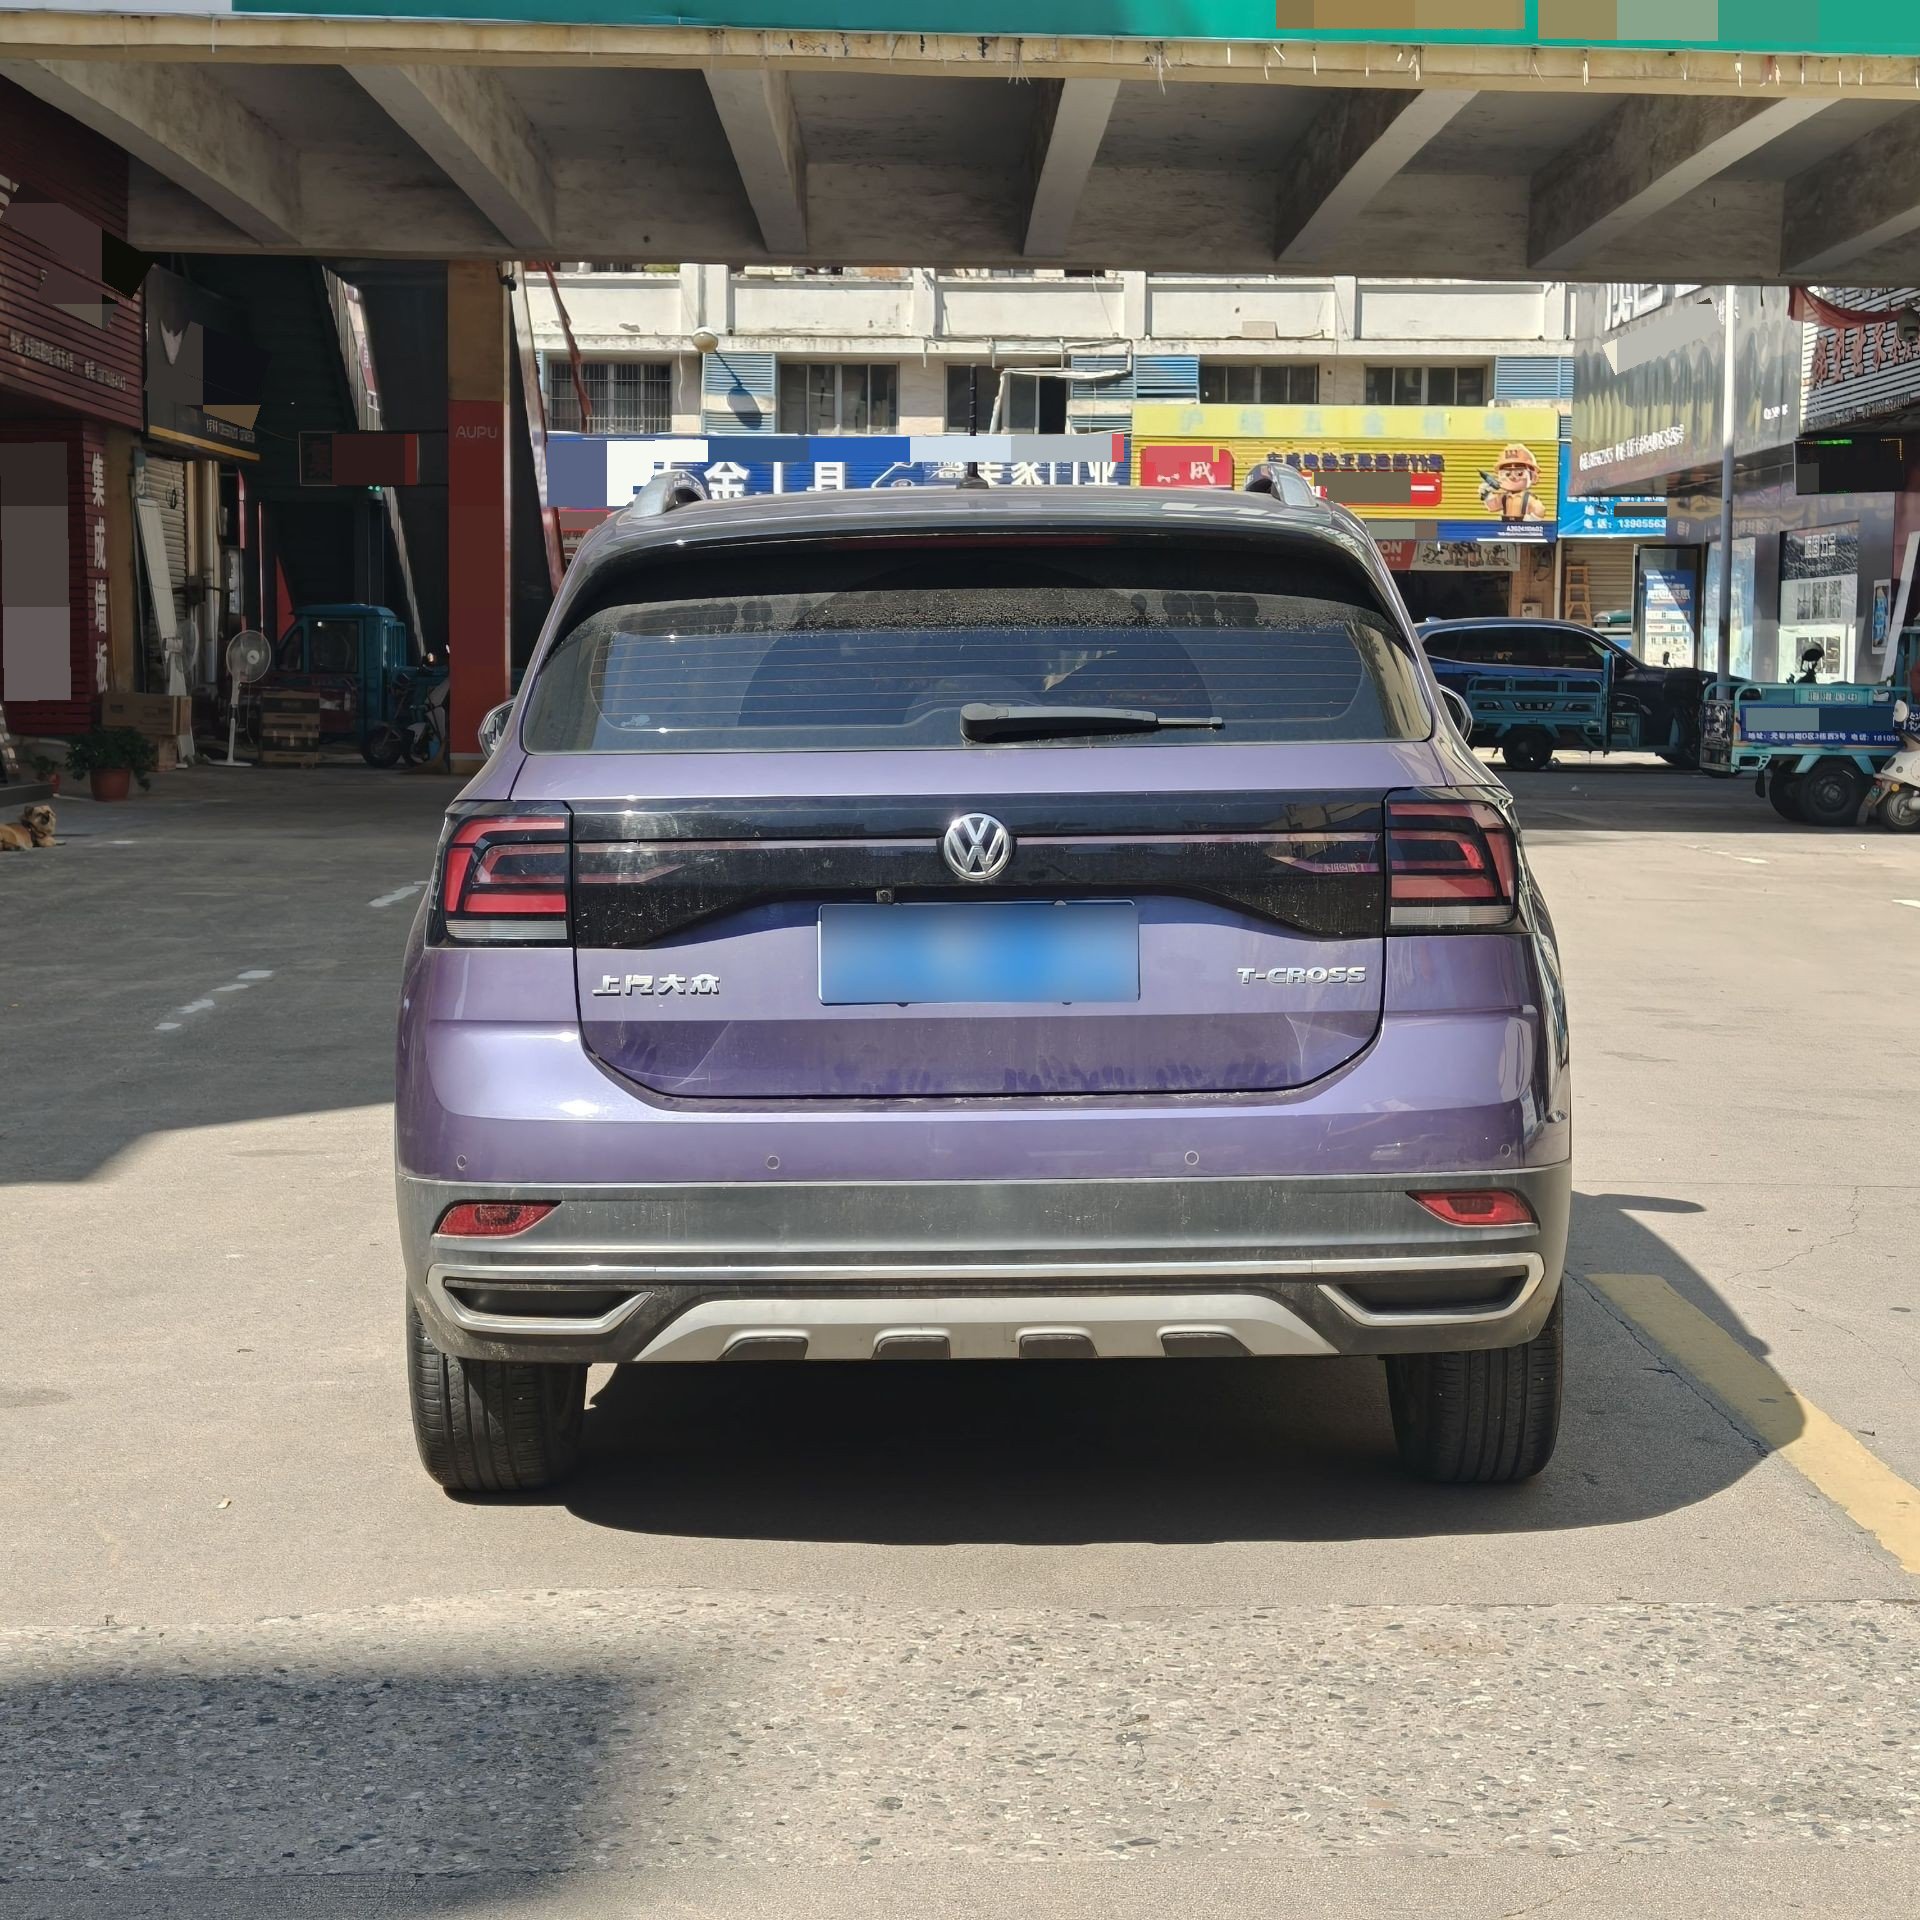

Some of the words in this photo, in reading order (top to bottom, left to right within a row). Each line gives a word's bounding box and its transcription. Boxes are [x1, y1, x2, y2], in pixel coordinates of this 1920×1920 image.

[455, 425, 498, 439] AUPU
[591, 973, 721, 996] 上汽大众
[1237, 966, 1367, 985] T-CROSS
